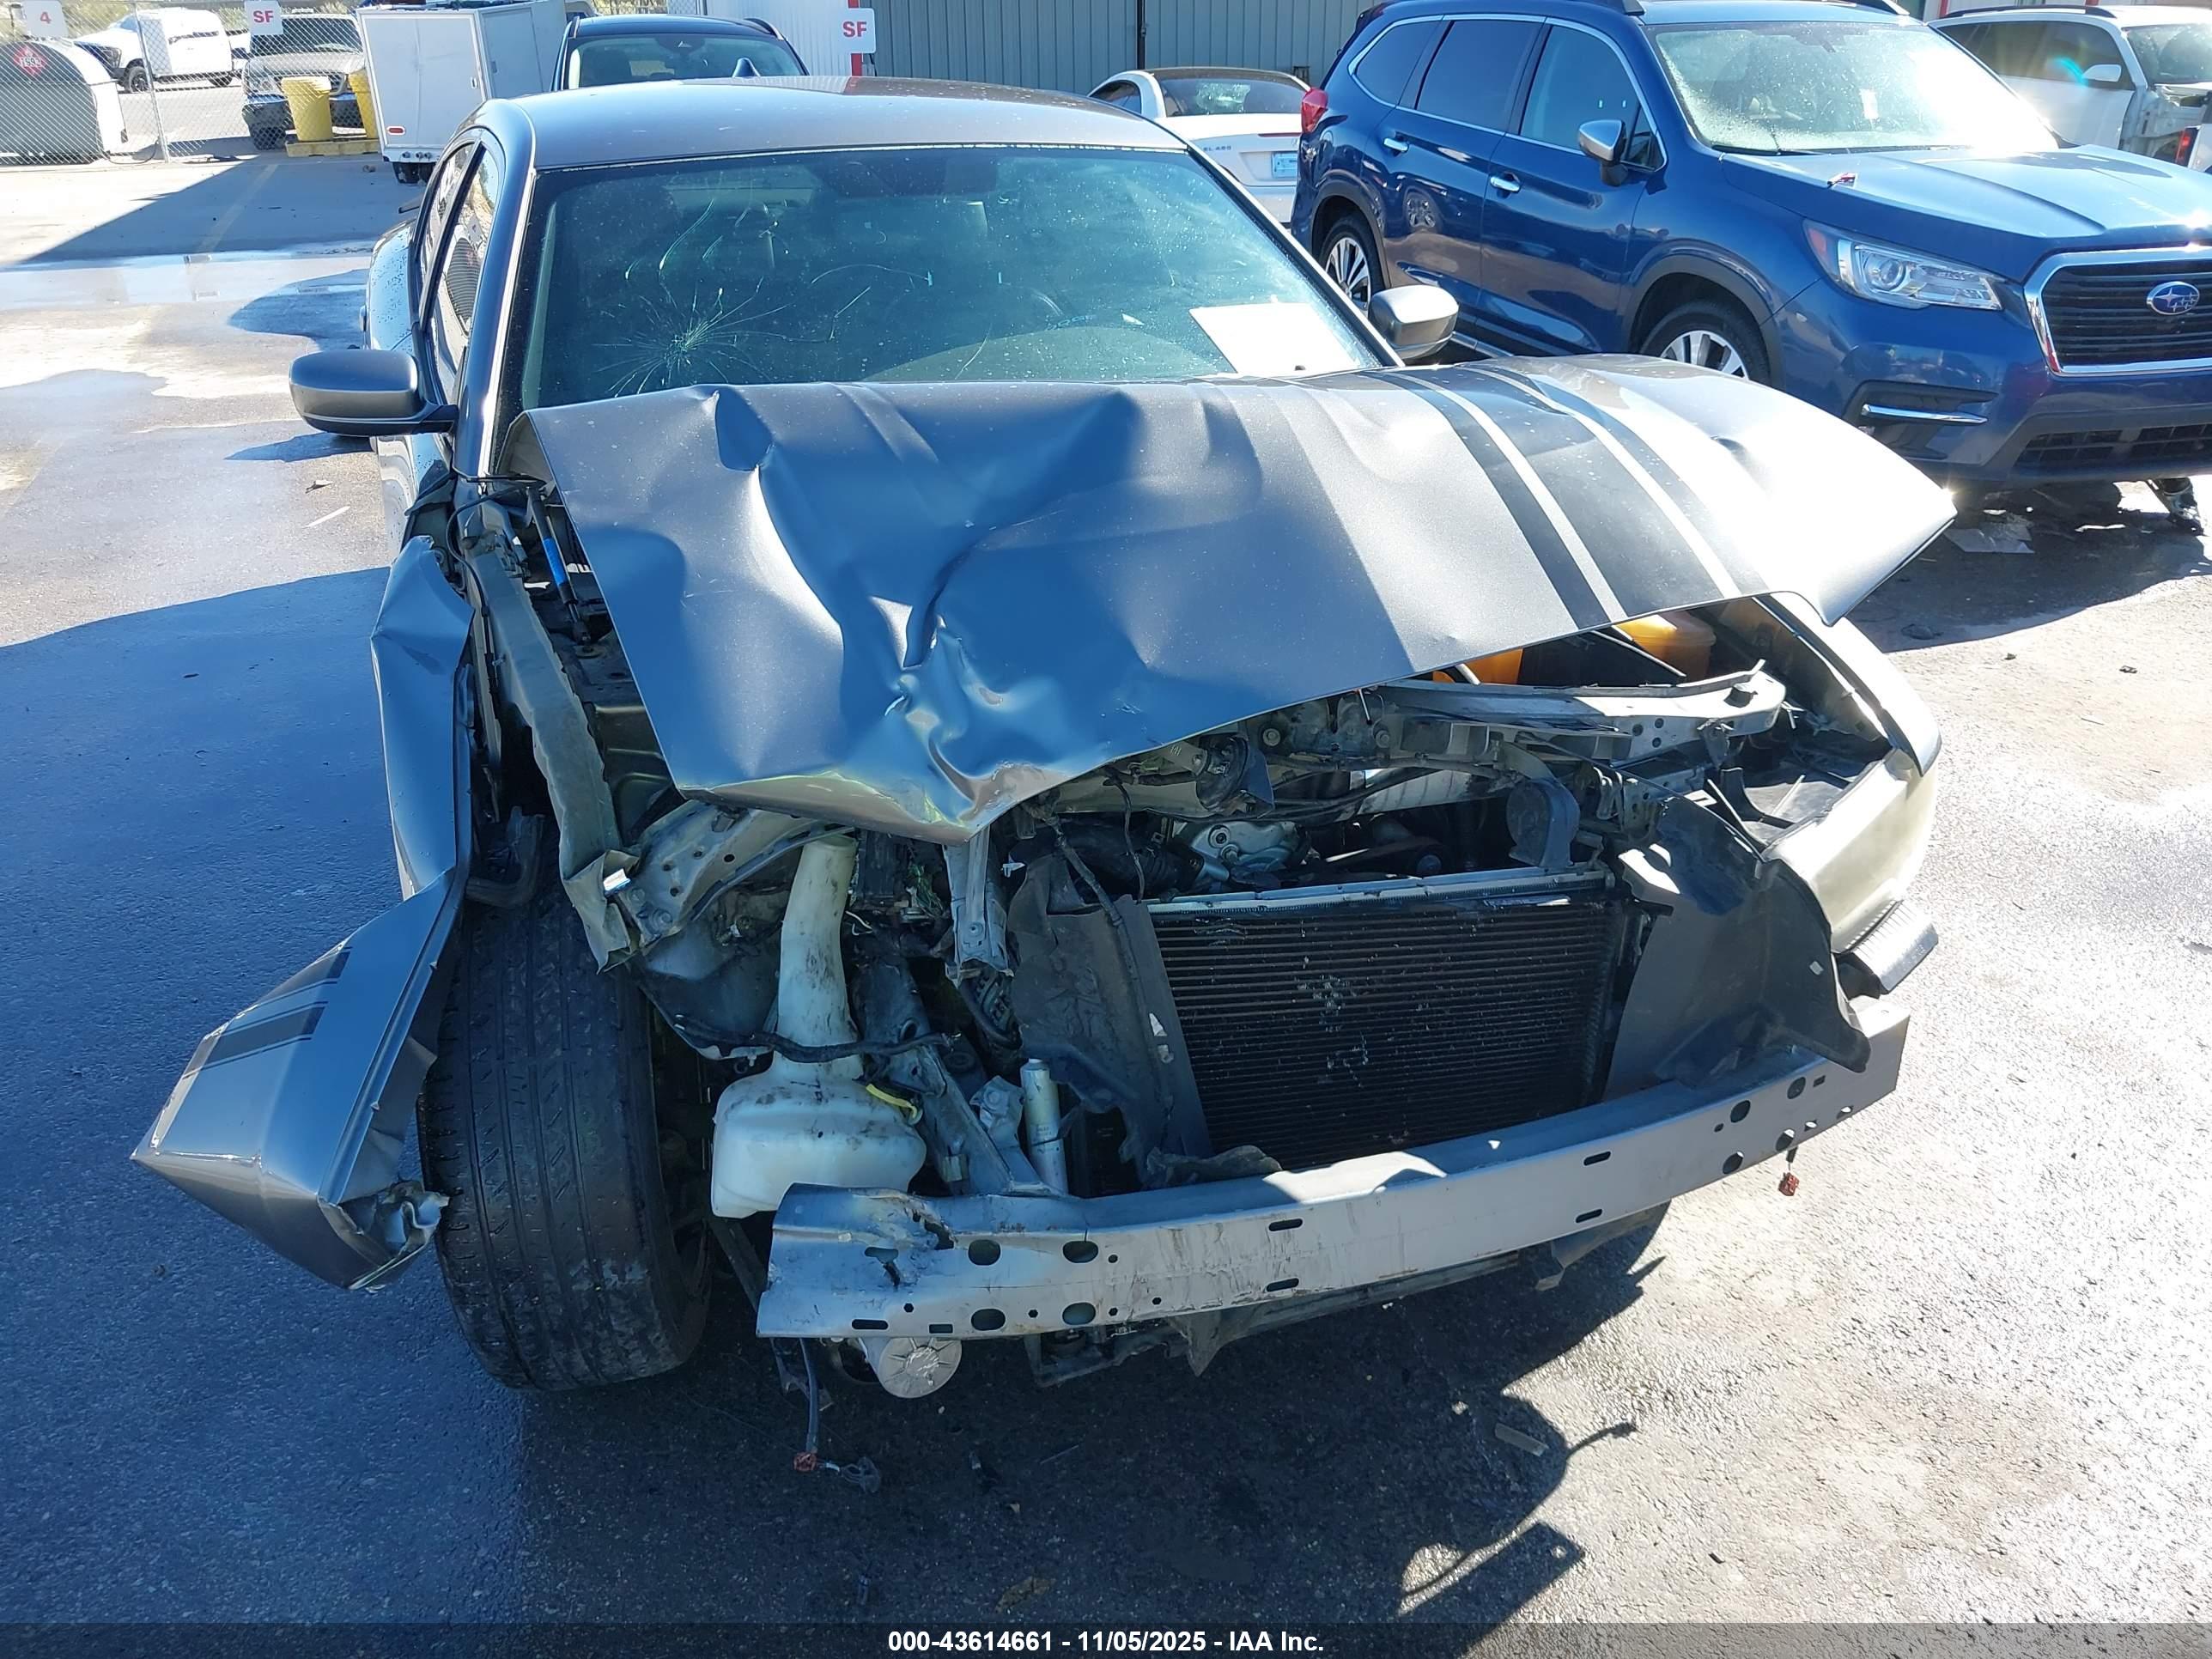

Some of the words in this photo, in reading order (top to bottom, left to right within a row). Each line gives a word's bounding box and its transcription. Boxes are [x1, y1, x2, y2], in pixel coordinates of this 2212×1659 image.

[40, 11, 52, 24] 4
[252, 10, 274, 23] SF
[842, 21, 867, 38] SF
